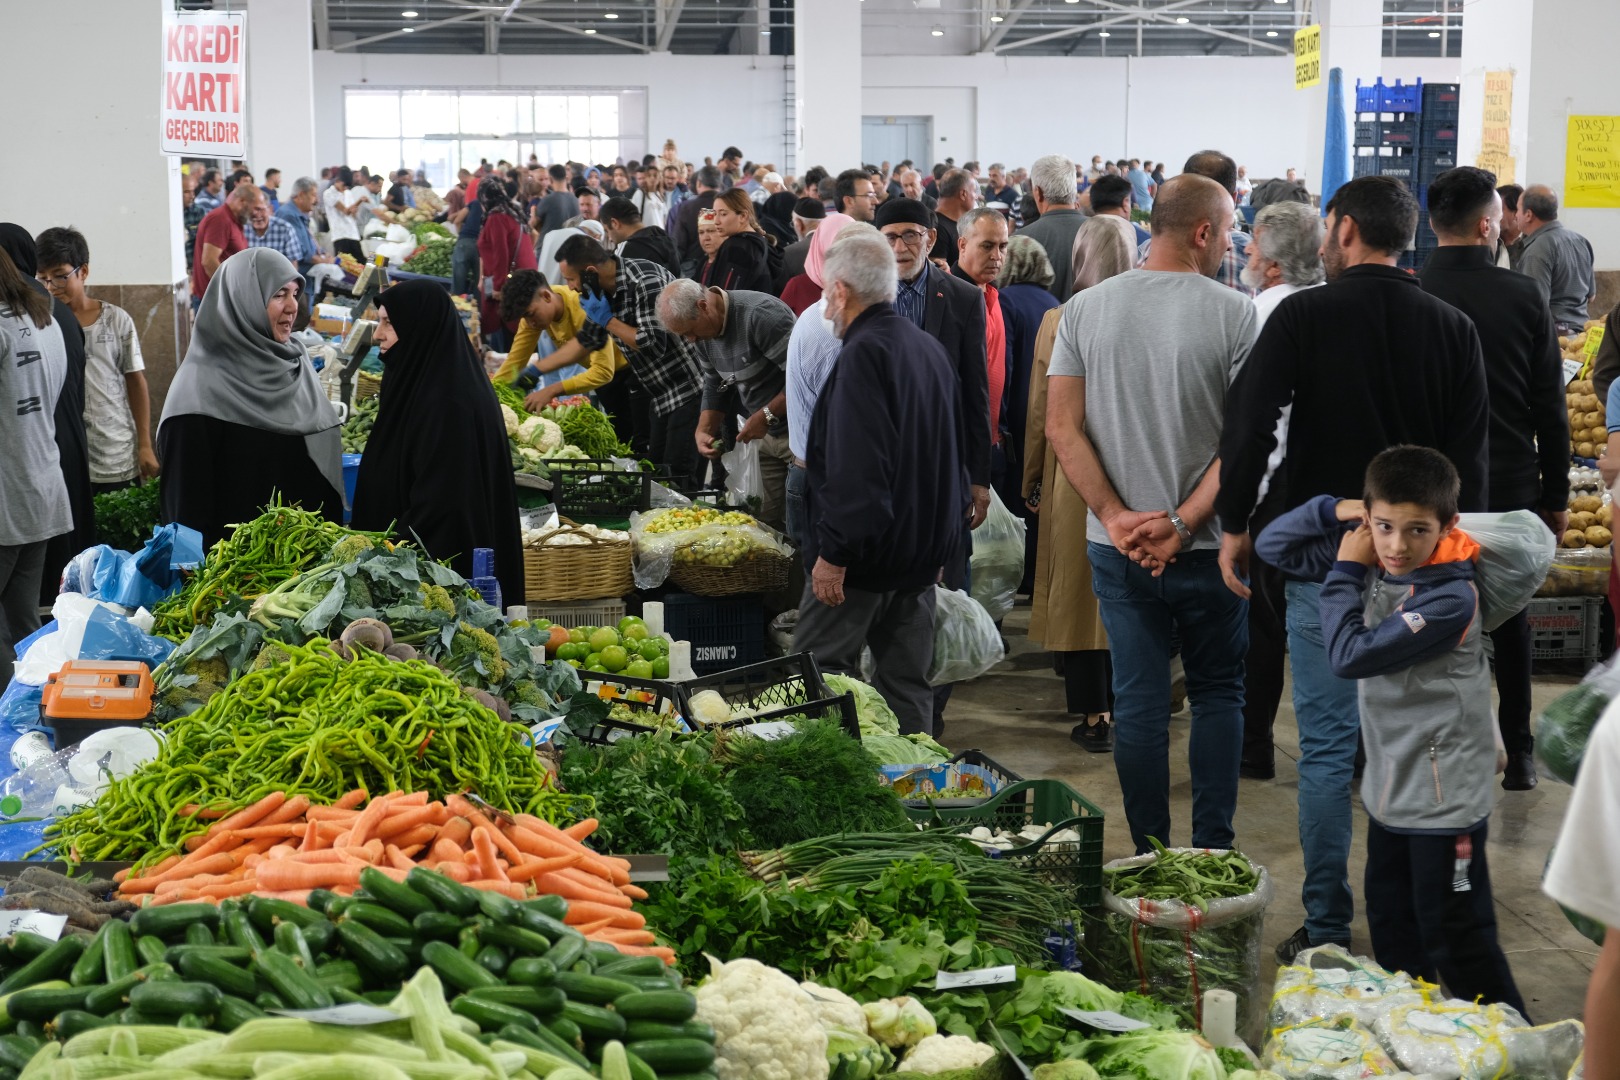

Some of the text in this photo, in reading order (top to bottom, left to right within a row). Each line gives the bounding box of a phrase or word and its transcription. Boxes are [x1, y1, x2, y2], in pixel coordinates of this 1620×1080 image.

[167, 25, 239, 63] KREDİ
[166, 72, 239, 113] KARTI
[166, 118, 240, 146] GEÇERLİDİR
[695, 645, 737, 661] C.MANSIZ
